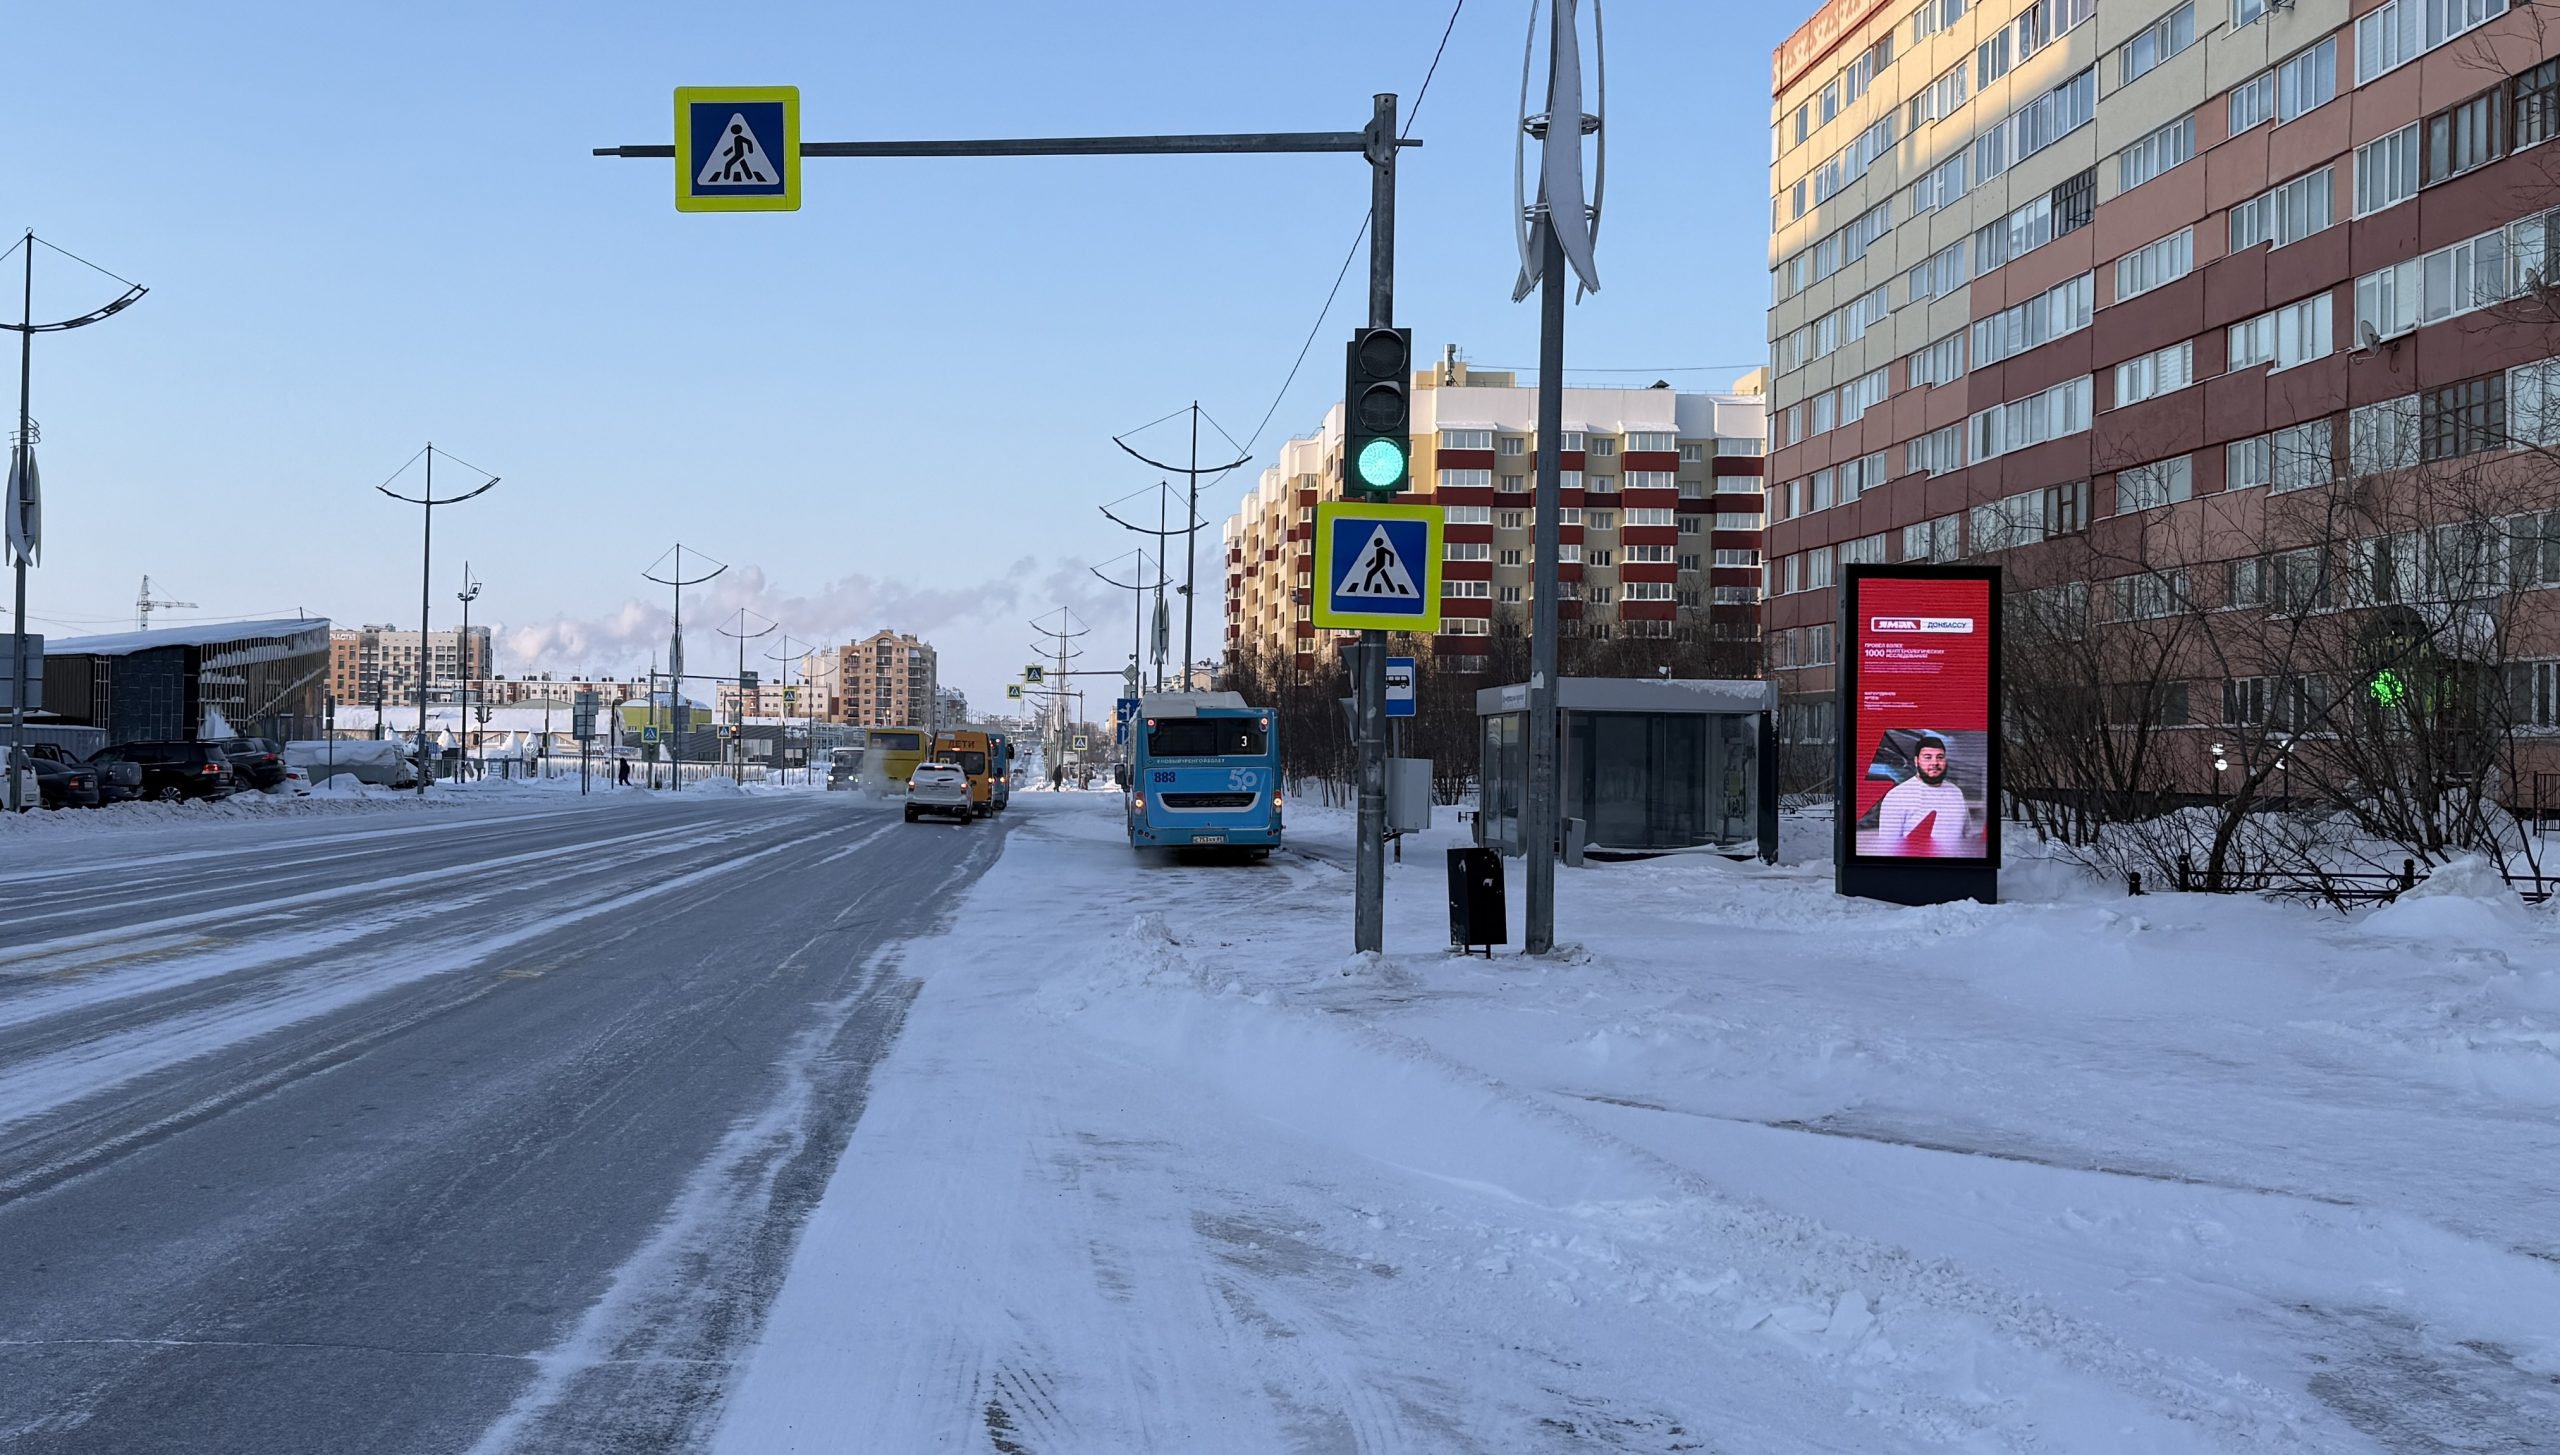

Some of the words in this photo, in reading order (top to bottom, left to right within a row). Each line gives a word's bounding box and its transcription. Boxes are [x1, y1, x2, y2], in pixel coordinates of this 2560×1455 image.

[1865, 649, 1884, 657] 1000
[948, 740, 975, 748] ДЕТИ
[1241, 736, 1247, 747] 3
[1154, 771, 1176, 783] 883
